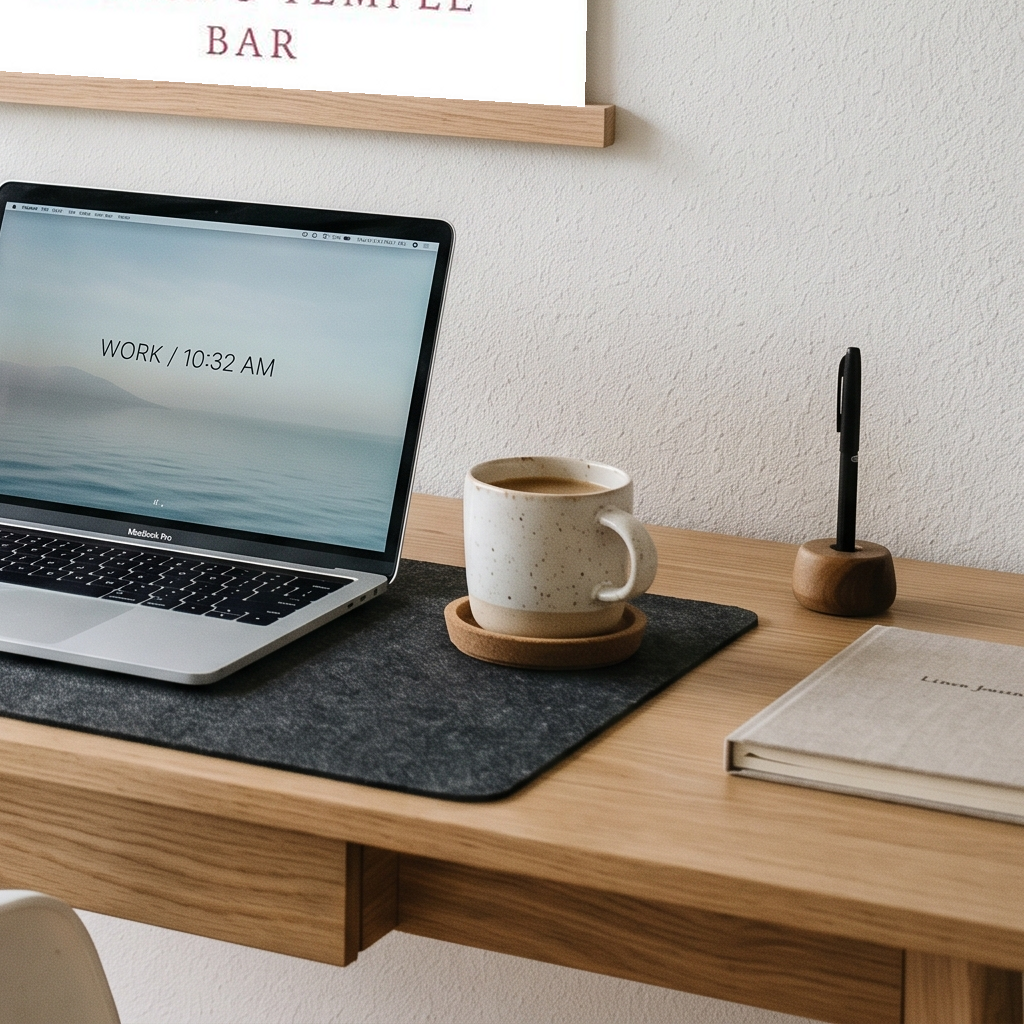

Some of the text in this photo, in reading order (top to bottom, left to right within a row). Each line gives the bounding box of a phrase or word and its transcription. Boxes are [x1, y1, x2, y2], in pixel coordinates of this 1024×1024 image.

[206, 25, 297, 60] BAR
[101, 338, 164, 364] WORK
[183, 348, 236, 373] 10:32
[239, 356, 275, 378] AM
[160, 532, 173, 542] Pro
